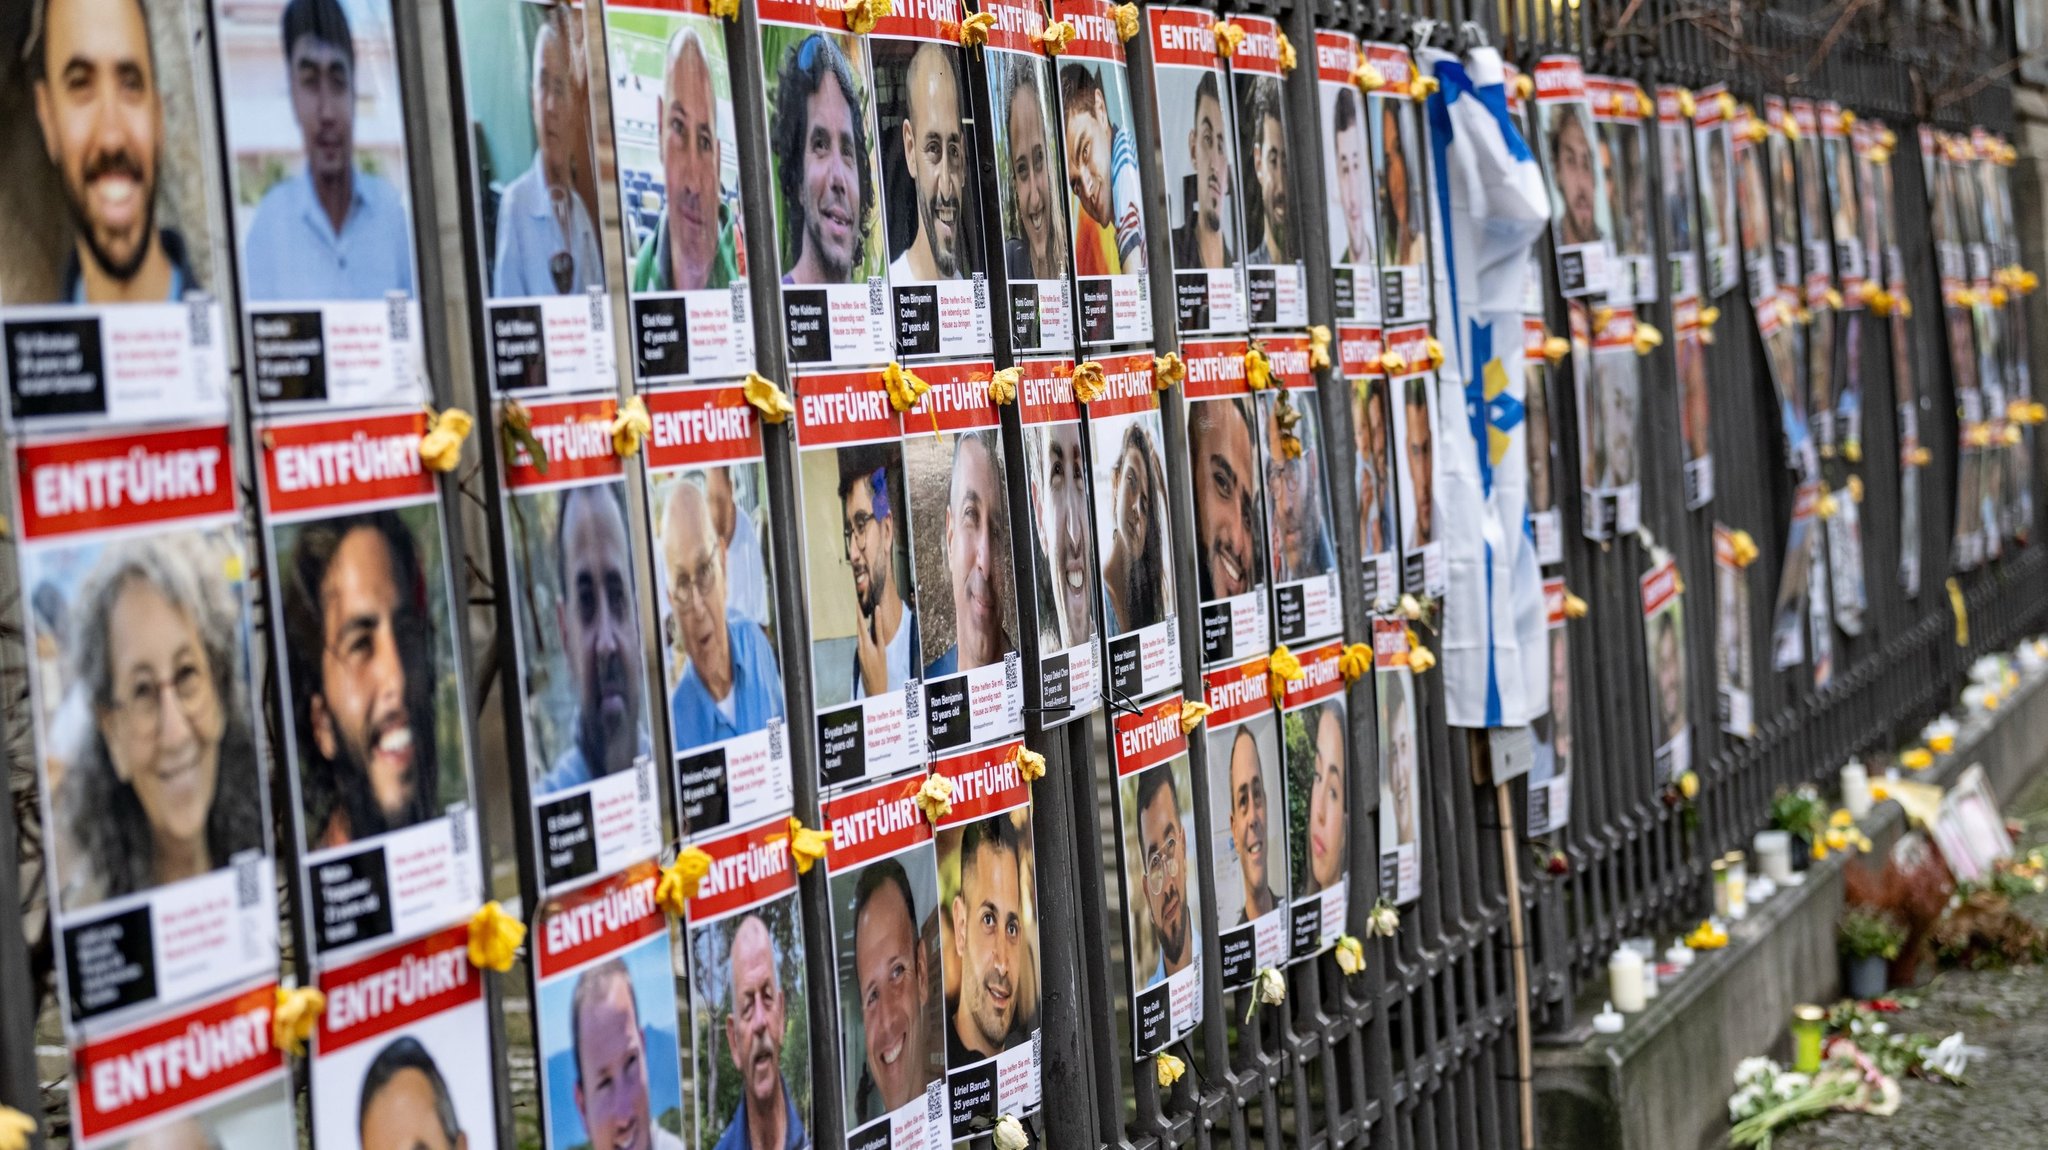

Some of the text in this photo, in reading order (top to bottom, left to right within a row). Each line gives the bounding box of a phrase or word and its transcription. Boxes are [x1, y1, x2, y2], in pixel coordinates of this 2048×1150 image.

[899, 293, 931, 305] Ben Binyamin
[901, 308, 916, 318] Cohen
[1090, 307, 1099, 316] years
[797, 322, 810, 333] years
[810, 320, 819, 331] old
[901, 322, 908, 332] 27
[908, 323, 921, 334] years
[792, 335, 807, 346] Israeli
[902, 336, 918, 347] Israeli
[1187, 352, 1245, 383] ENTFÜHRT
[1023, 373, 1075, 407] ENTFÜHRT
[1095, 368, 1152, 402] NTFÜHRT
[803, 386, 890, 426] ENTFÜHRT
[652, 402, 751, 447] ENTFÜHRT
[275, 430, 422, 492] ENTFÜHRT
[33, 445, 220, 518] ENTFÜHRT
[1120, 664, 1129, 675] years
[931, 692, 963, 707] Ron Benjamin
[1210, 673, 1268, 712] ENTFÜHRT
[931, 706, 960, 722] 53 years old
[932, 723, 947, 736] Israeli
[1122, 713, 1181, 758] ENTFÜHRT
[832, 742, 845, 755] years
[846, 737, 855, 748] old
[825, 755, 841, 769] Israeli
[832, 795, 922, 851] ENTFÜHRT
[698, 837, 788, 899] ENTFÜHRT
[547, 877, 656, 955] ENTFÜHRT
[327, 945, 468, 1033] ENTFÜHRT
[1149, 1014, 1159, 1027] years
[91, 1008, 270, 1114] ENTFÜHRT
[954, 1078, 990, 1097] Uriel Baruch
[953, 1091, 990, 1110] 35 years old
[953, 1110, 972, 1124] Israeli
